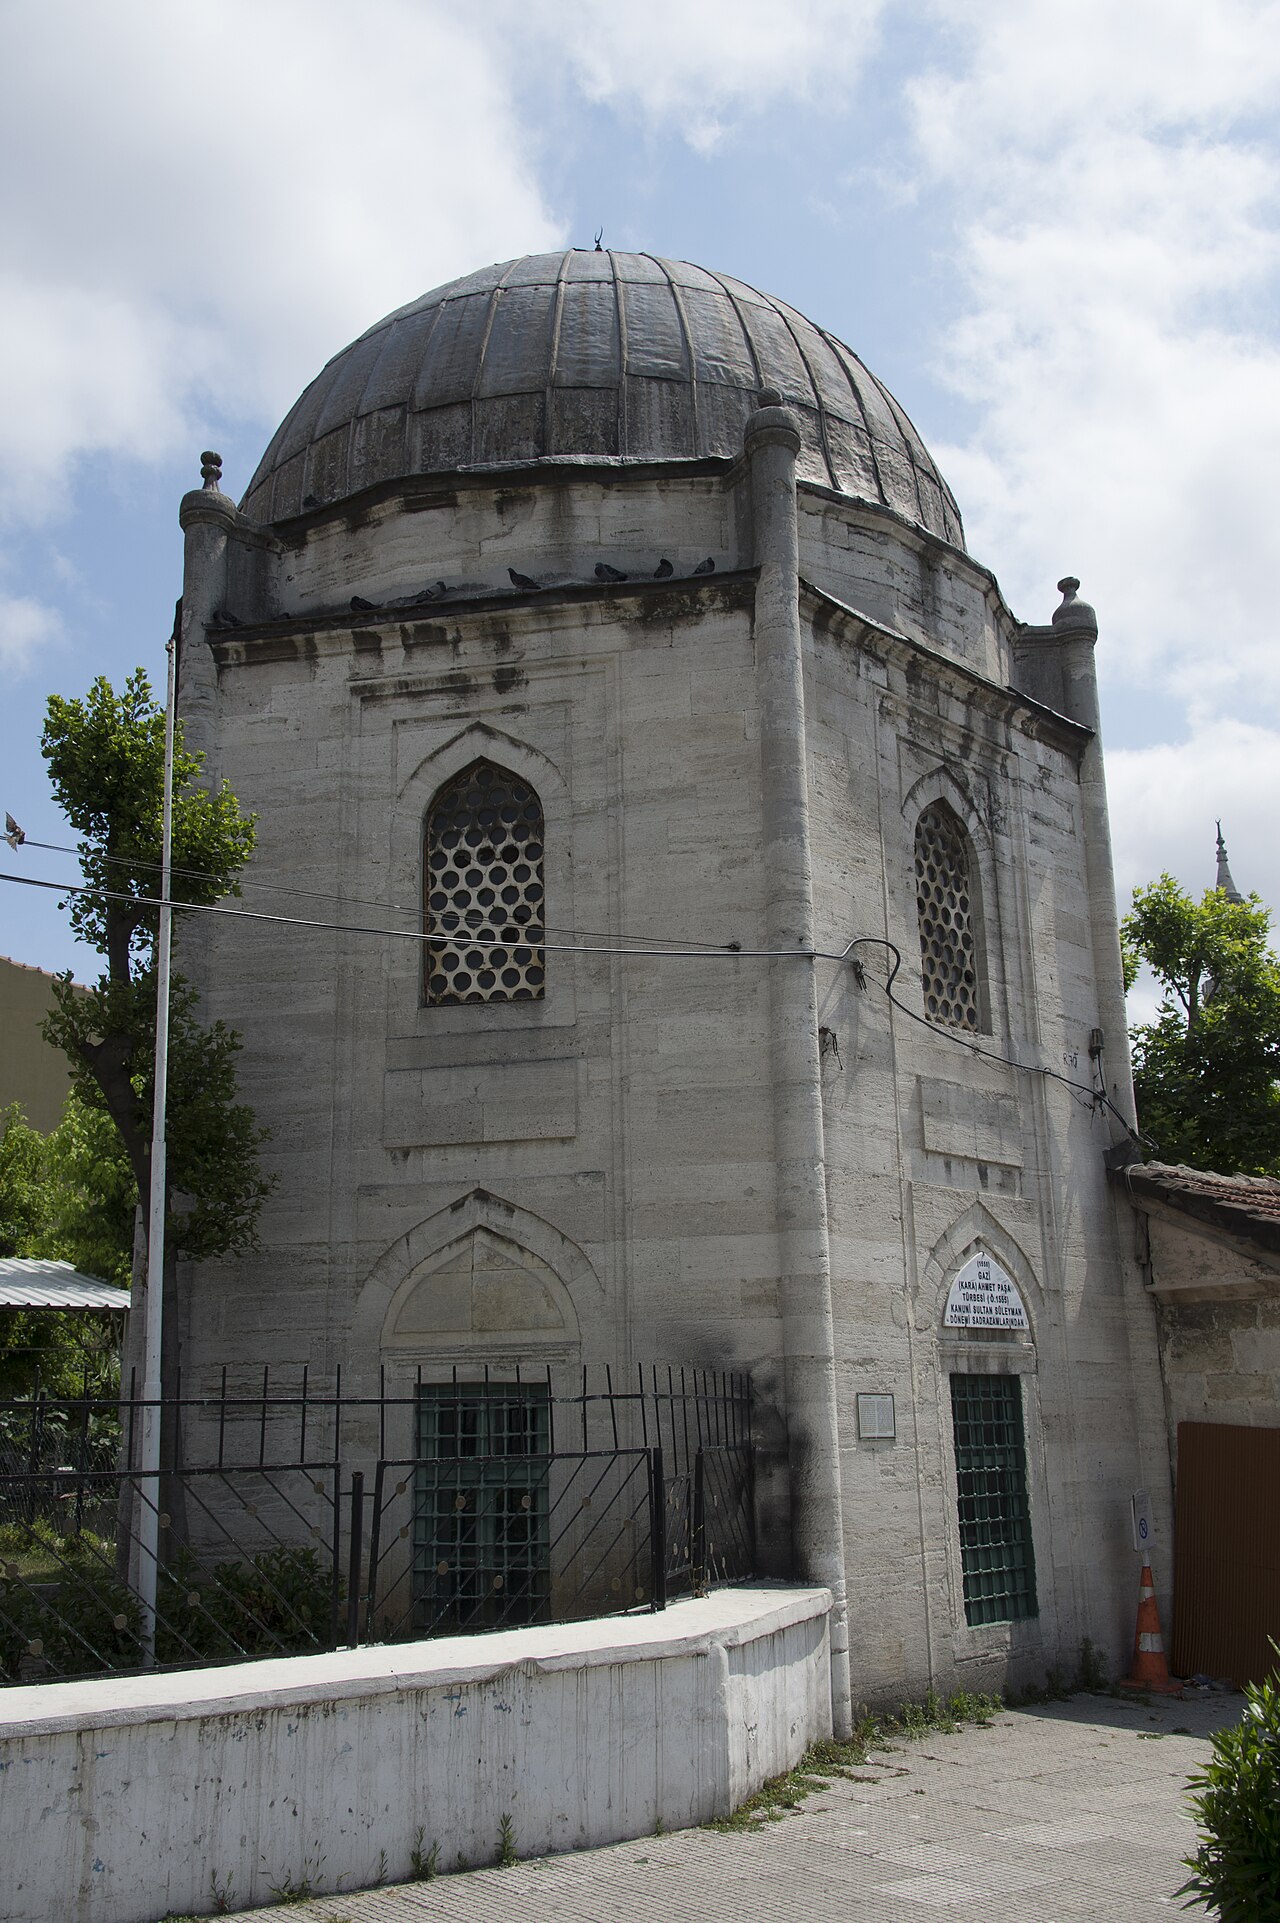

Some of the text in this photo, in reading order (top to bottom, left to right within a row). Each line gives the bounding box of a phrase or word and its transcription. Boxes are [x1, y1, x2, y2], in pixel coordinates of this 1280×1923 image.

[978, 1271, 990, 1280] GAZİ
[998, 1284, 1011, 1294] PAŞA
[962, 1292, 985, 1302] TÜRBESİ
[951, 1304, 1022, 1316] KANUNİ SULTAN SÜLEYMAN
[950, 1315, 1024, 1326] DÖNEMİ SADRAZAMLARINDAN
